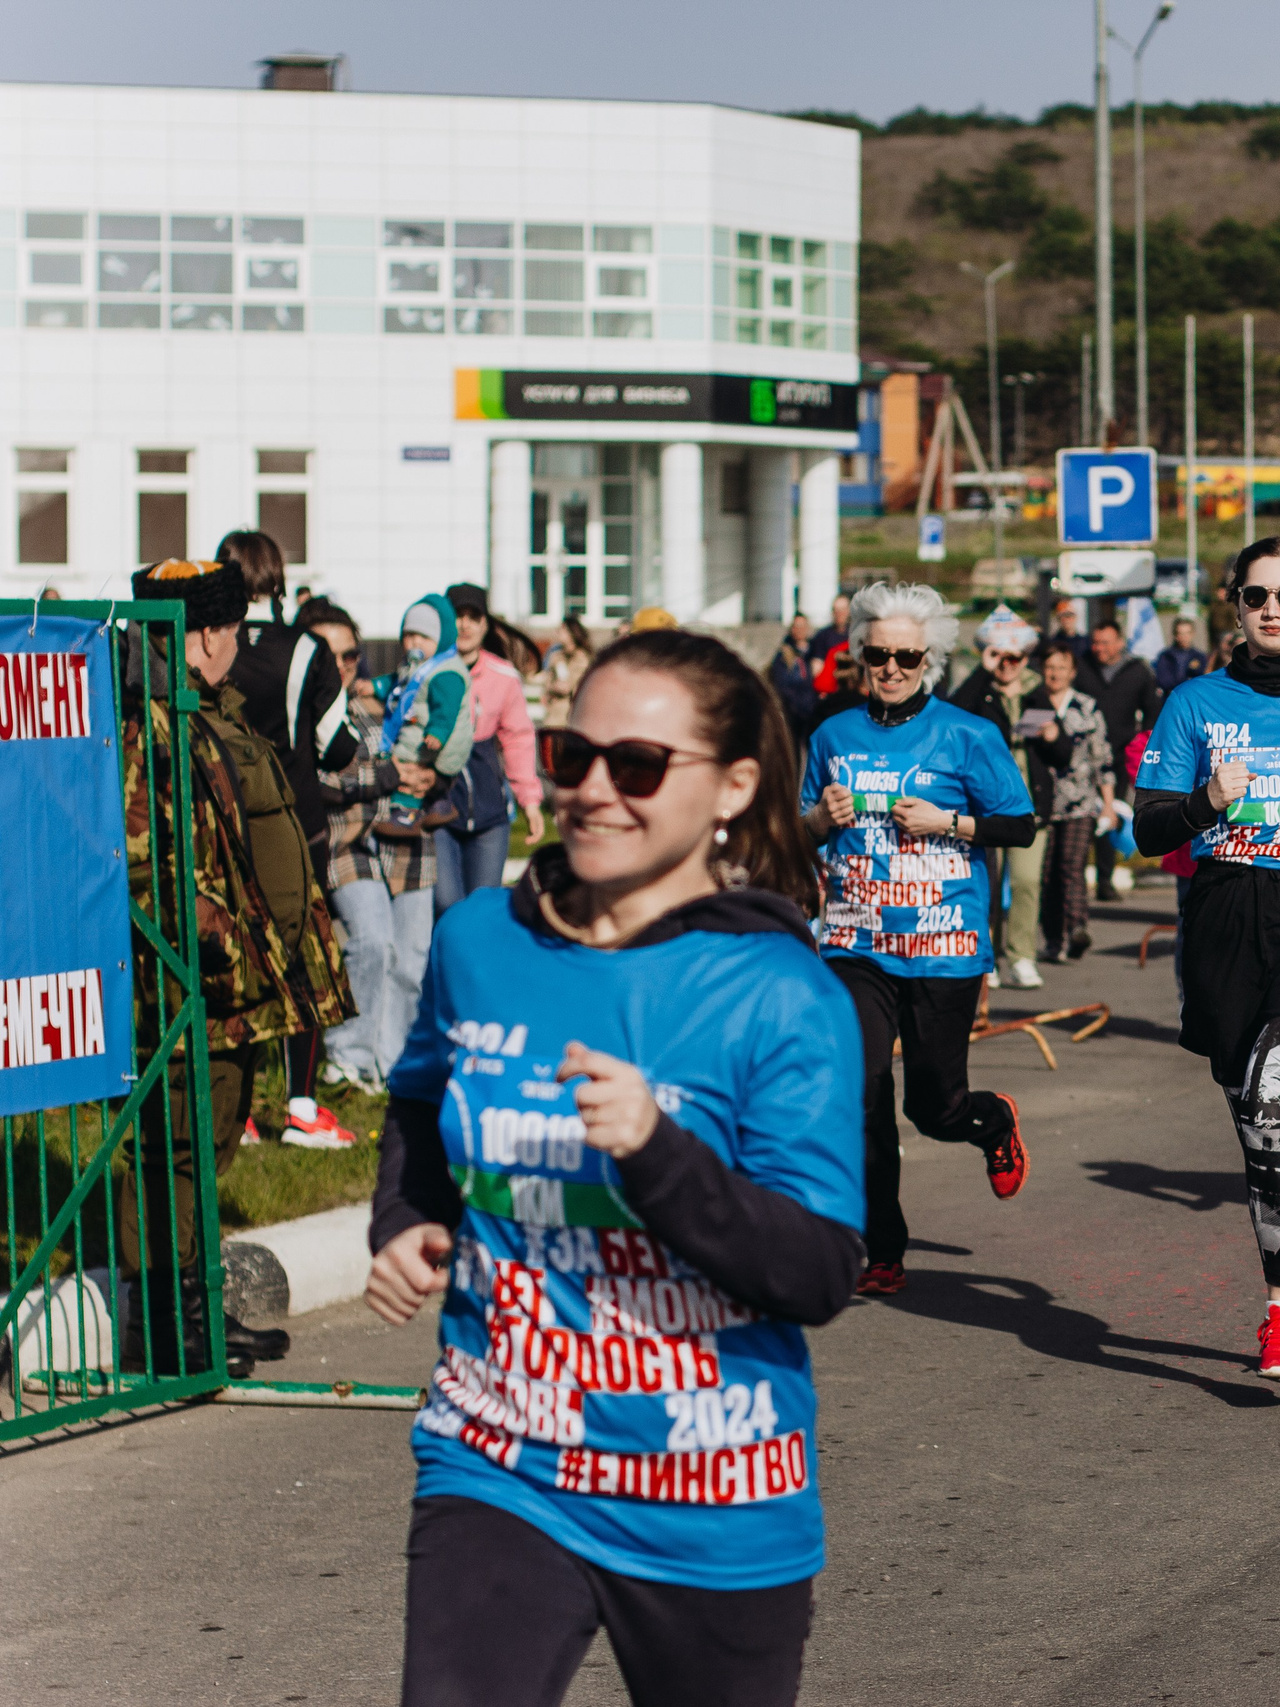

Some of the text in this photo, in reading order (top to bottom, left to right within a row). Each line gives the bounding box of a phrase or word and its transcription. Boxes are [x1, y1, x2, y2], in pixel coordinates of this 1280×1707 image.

[1088, 465, 1135, 533] P
[1205, 722, 1251, 748] 2024
[854, 771, 900, 792] 10035
[916, 904, 964, 932] 2024
[872, 931, 977, 958] #ЕДИНСТВО
[664, 1379, 779, 1451] 2024
[556, 1428, 808, 1505] #ЕДИНСТВО
